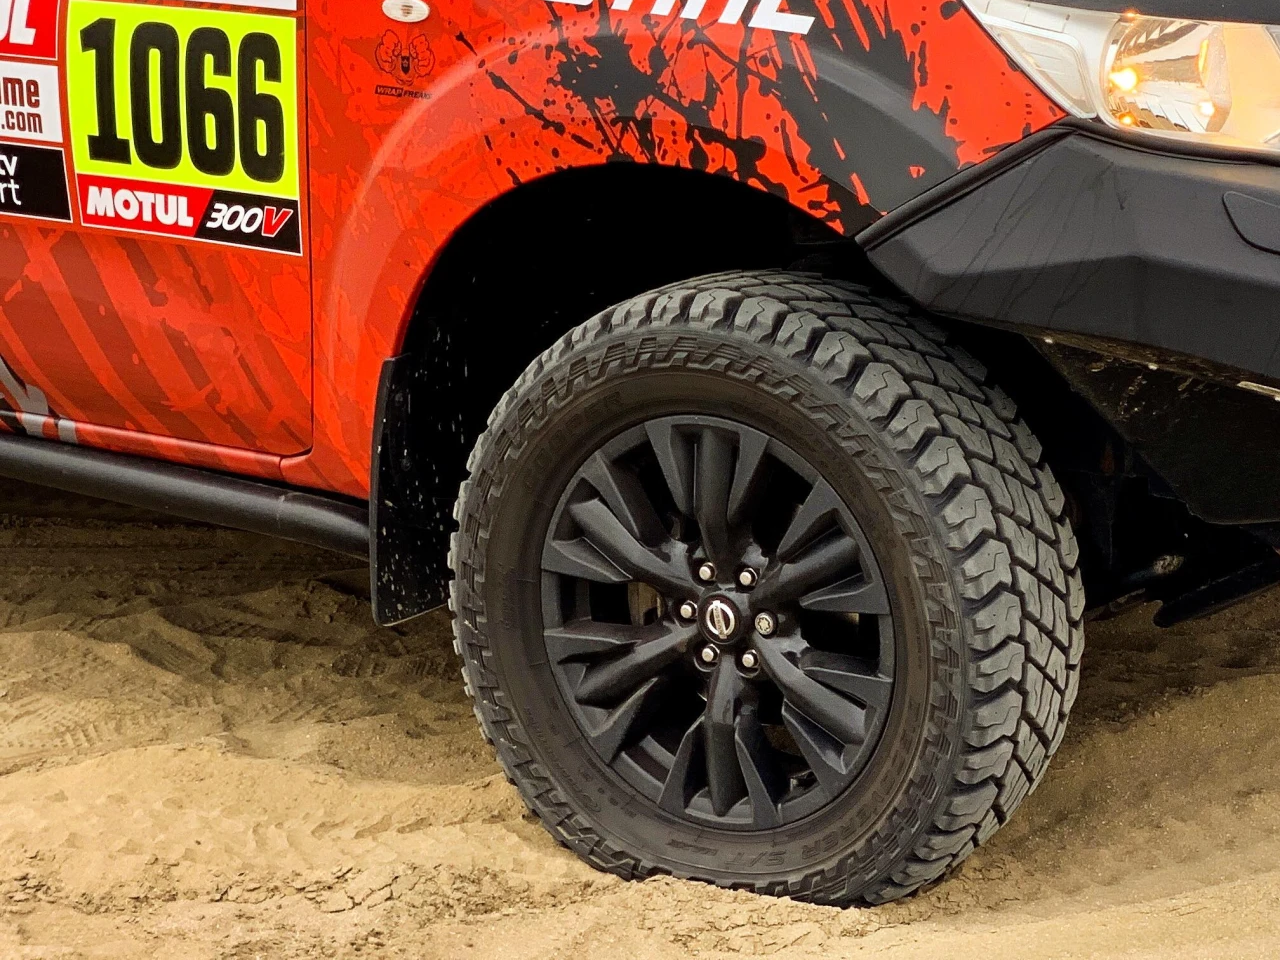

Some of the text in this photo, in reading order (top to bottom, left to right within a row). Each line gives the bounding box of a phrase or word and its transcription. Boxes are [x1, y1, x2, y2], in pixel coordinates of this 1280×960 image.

[79, 17, 285, 184] 1066
[86, 185, 294, 238] MOTUL 300V
